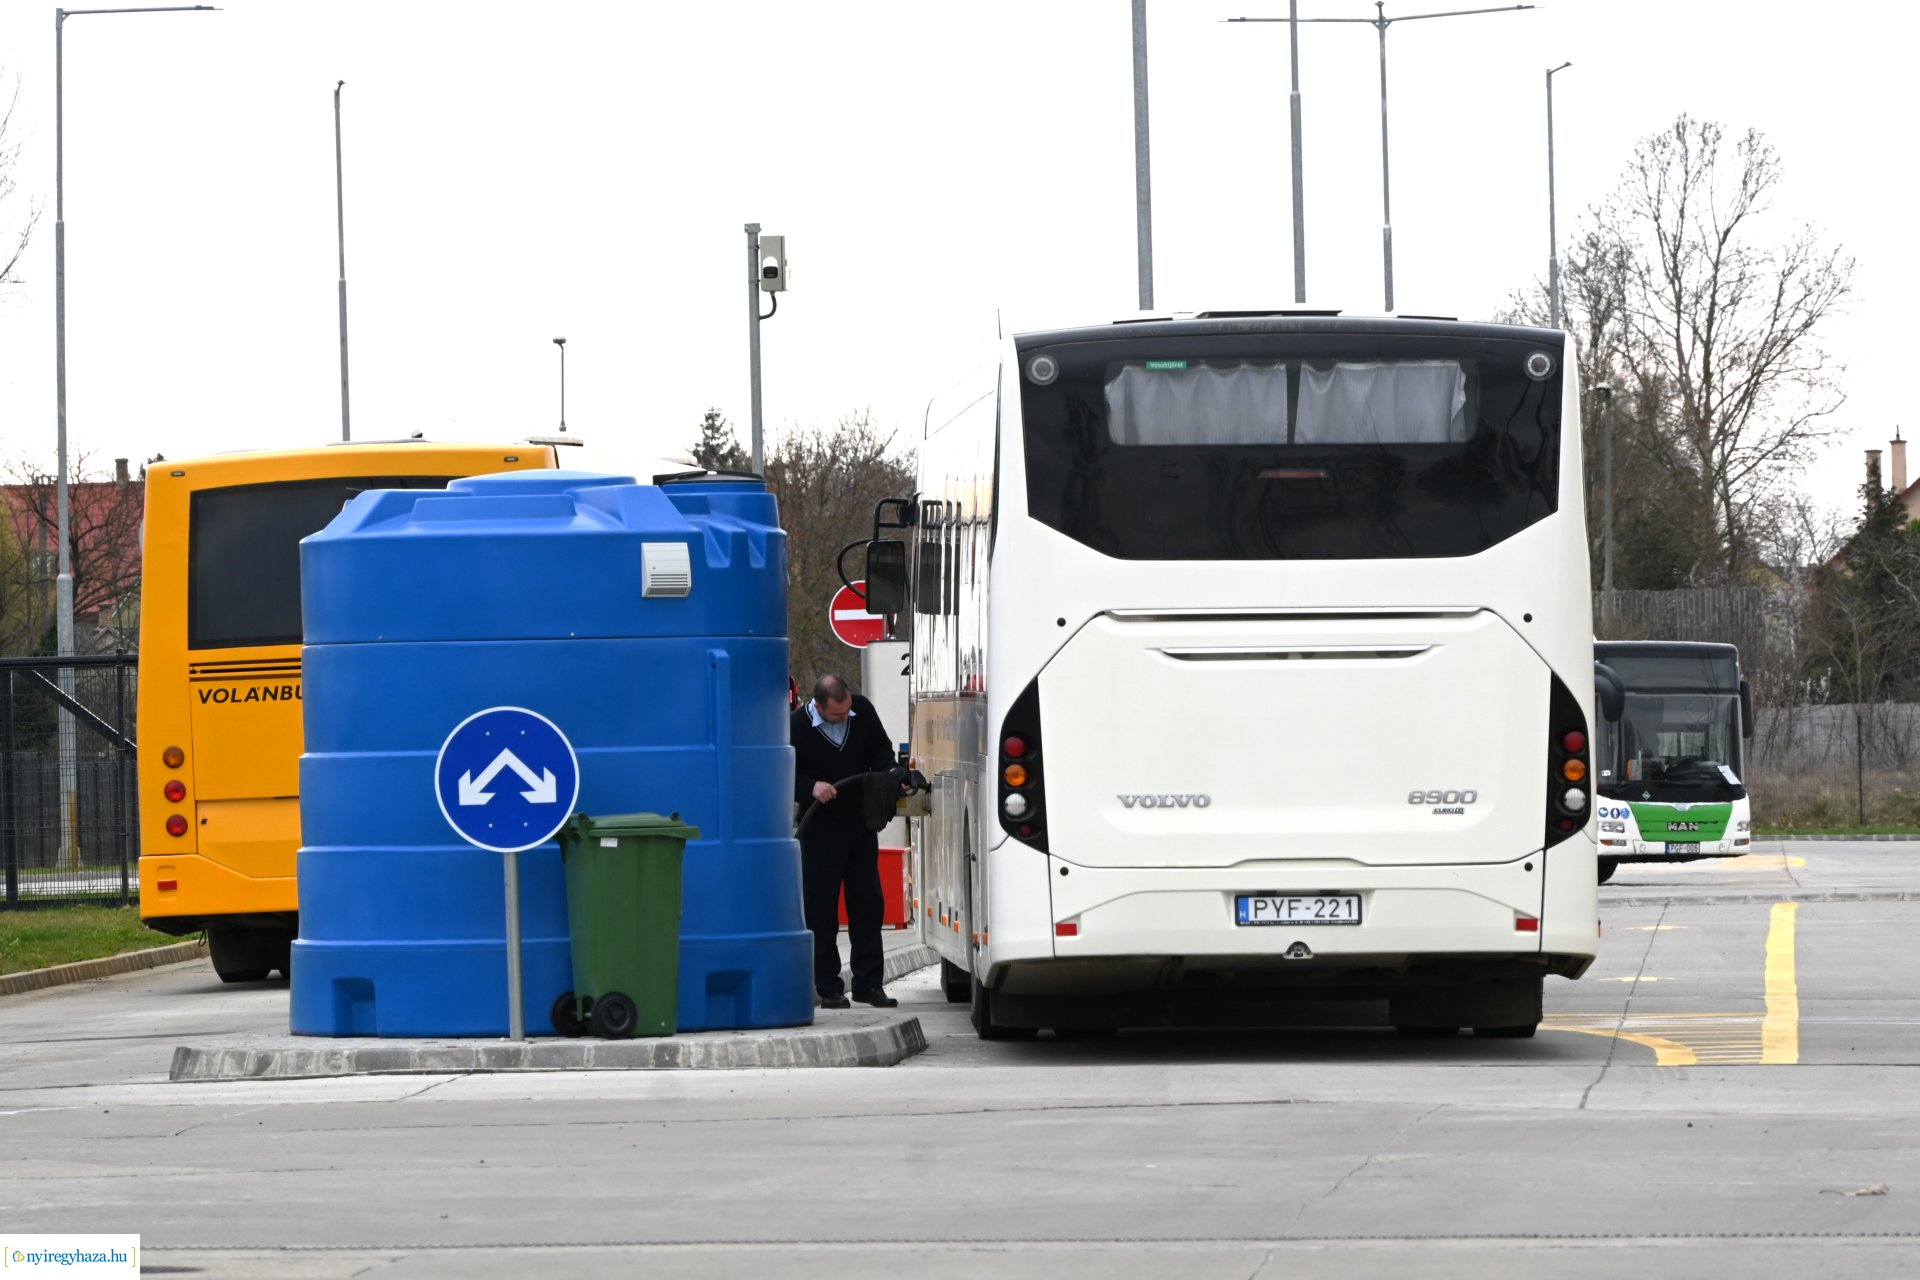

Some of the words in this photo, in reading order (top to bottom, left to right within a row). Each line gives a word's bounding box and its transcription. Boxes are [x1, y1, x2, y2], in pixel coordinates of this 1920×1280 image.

[1117, 794, 1212, 809] VOLVO
[1408, 790, 1478, 805] 8900
[1668, 822, 1699, 831] MAN
[1254, 899, 1353, 919] PYF-221
